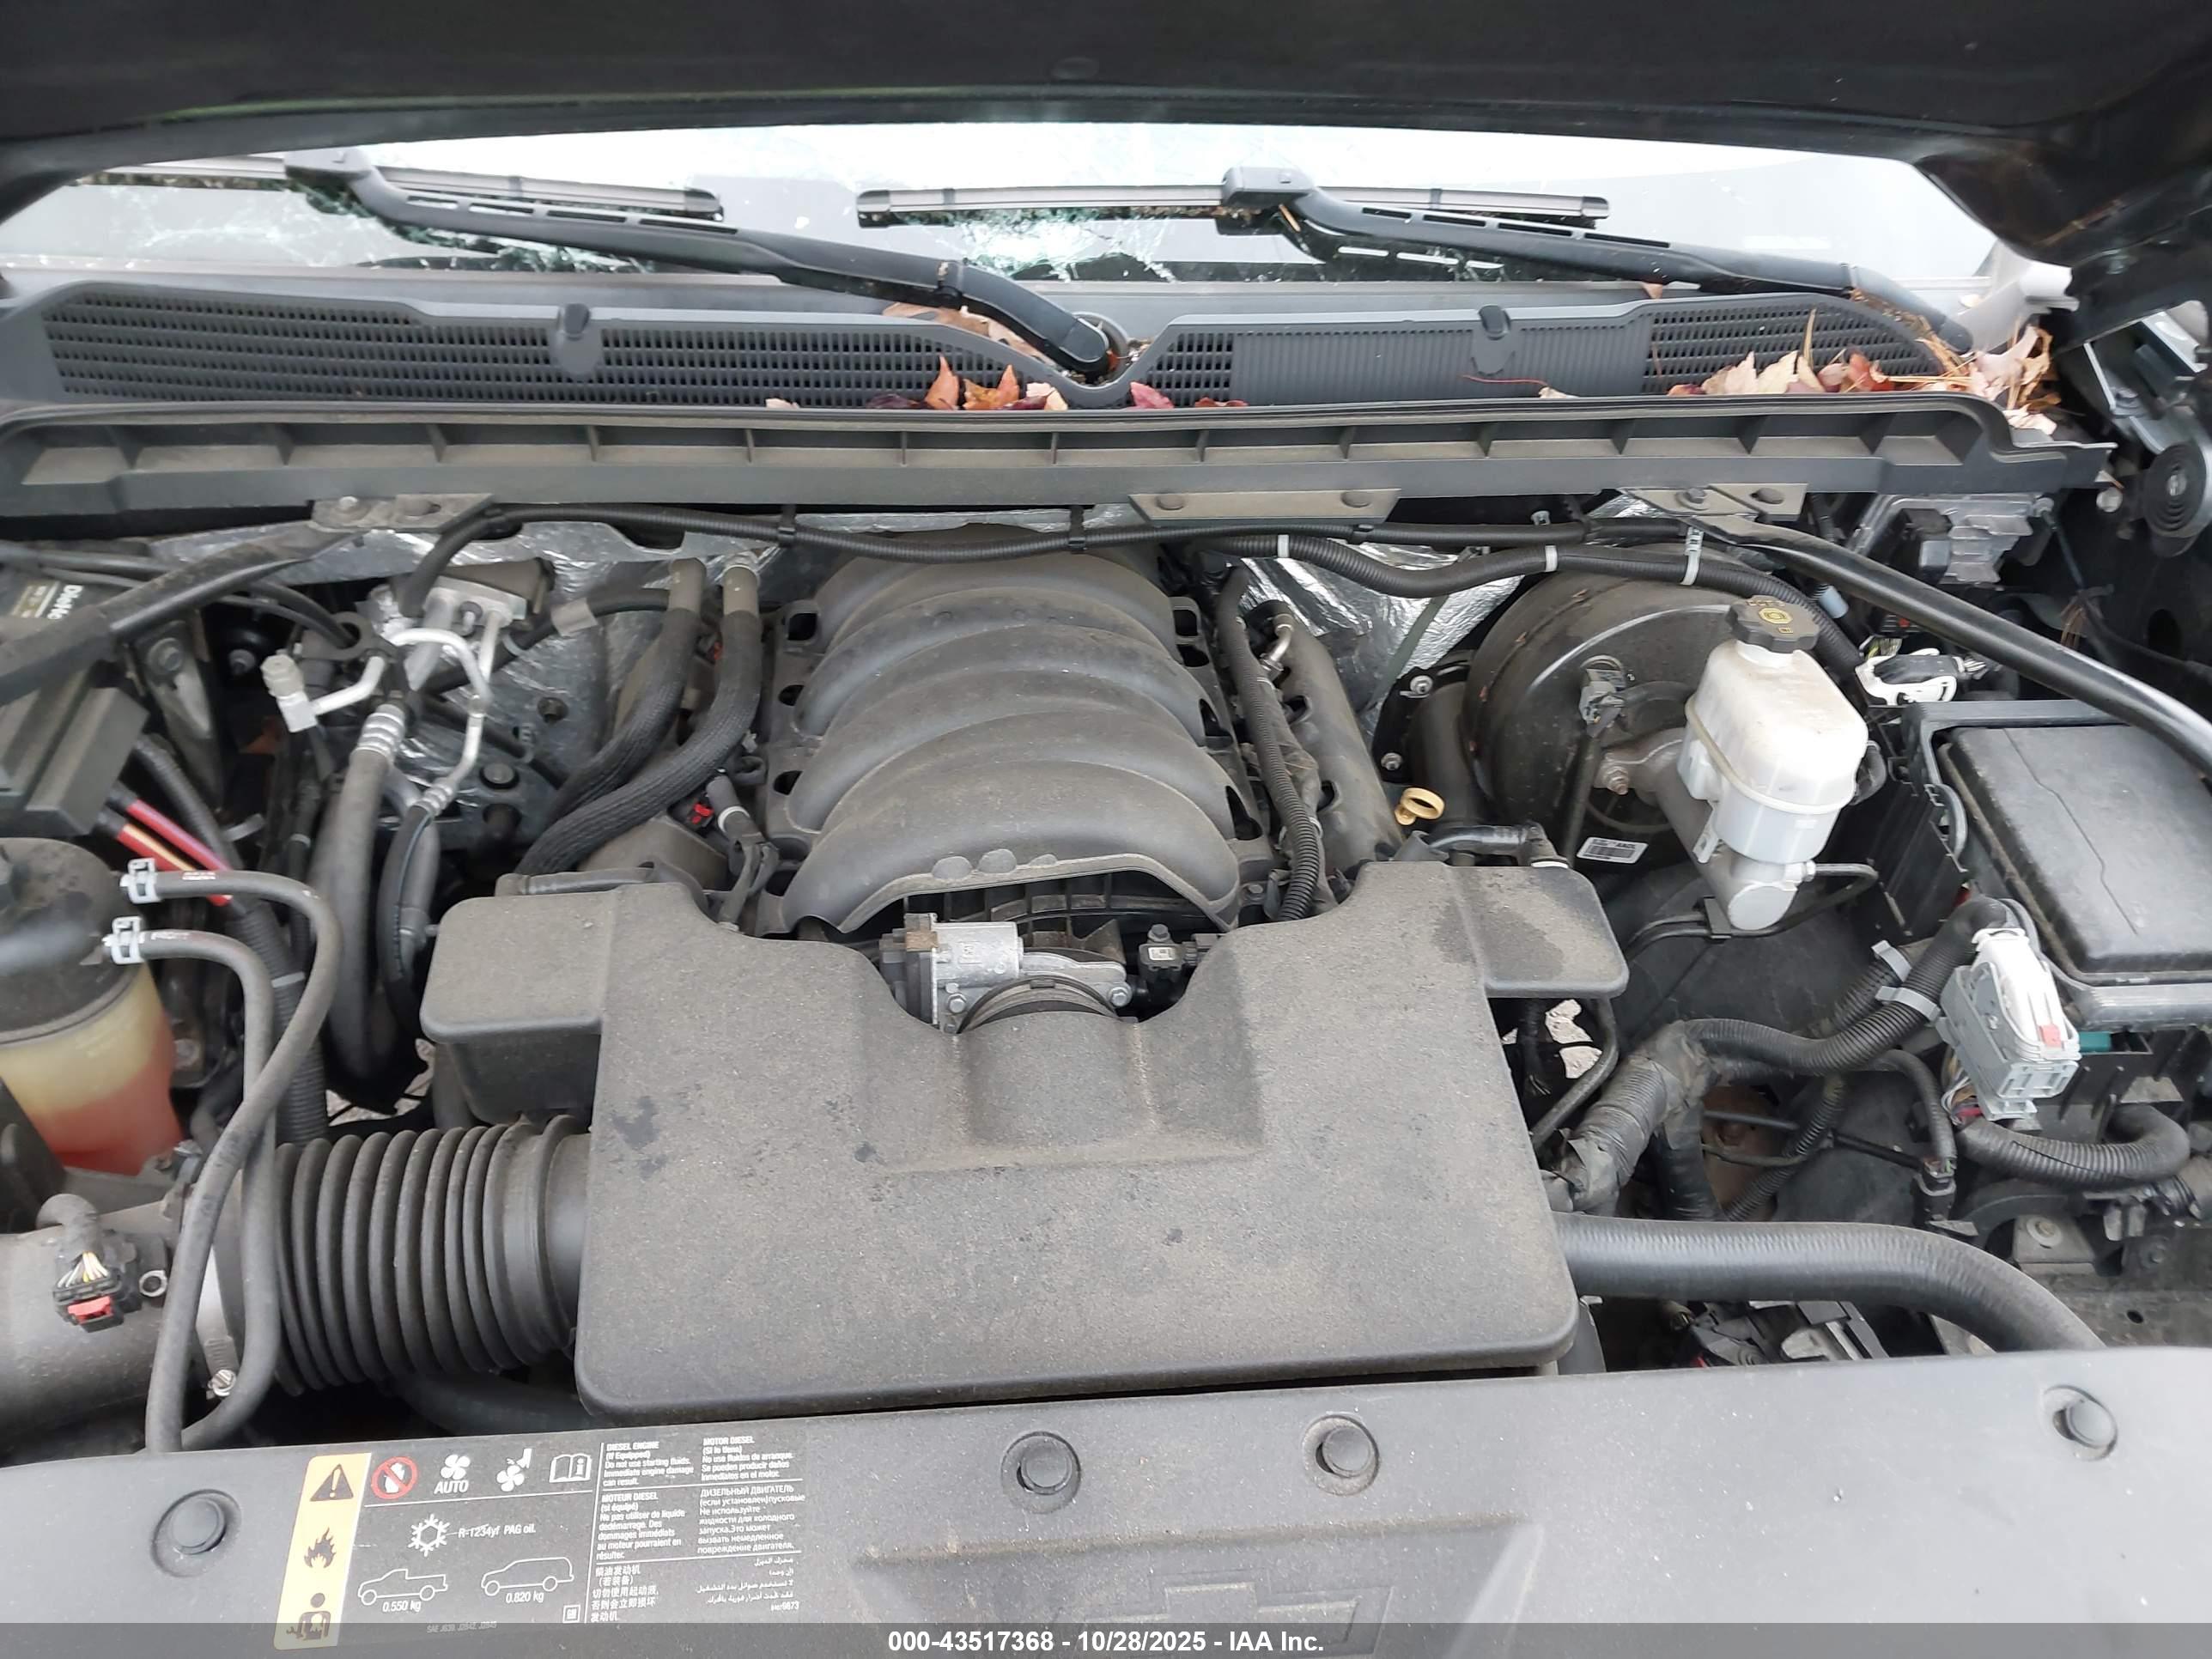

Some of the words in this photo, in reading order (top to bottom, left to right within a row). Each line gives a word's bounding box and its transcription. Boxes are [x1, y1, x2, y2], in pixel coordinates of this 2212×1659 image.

[606, 1443, 631, 1451] DIESEL
[632, 1441, 659, 1449] ENGINE
[703, 1437, 729, 1446] MOTOR
[730, 1436, 755, 1444] DIESEL
[641, 1459, 669, 1468] starting
[712, 1463, 738, 1473] pueden
[738, 1462, 768, 1471] producir
[768, 1461, 790, 1469] daños
[604, 1468, 641, 1477] Immediate
[641, 1468, 665, 1476] engine
[666, 1466, 694, 1474] damage
[434, 1480, 469, 1494] AUTO
[700, 1486, 750, 1498] ДИЗЕЛЬНЫЙ
[750, 1485, 794, 1495] ДВИГАТЕЛЬ
[602, 1493, 632, 1503] MOTEUR
[633, 1492, 659, 1501] DIESEL
[625, 1511, 650, 1520] utiliser
[661, 1509, 686, 1518] liquide
[711, 1504, 762, 1515] используйте
[698, 1516, 738, 1525] жидкости
[738, 1515, 753, 1523] для
[753, 1513, 795, 1522] холодного
[458, 1523, 501, 1539] R-1234yf
[503, 1524, 522, 1535] PAG
[598, 1531, 637, 1540] dommages
[638, 1528, 676, 1538] immédiats
[607, 1540, 634, 1549] moteur
[634, 1538, 672, 1549] pourraient
[697, 1535, 730, 1544] вызвать
[731, 1533, 784, 1542] немедленное
[505, 1590, 531, 1603] 0.820
[532, 1590, 544, 1602] kg
[382, 1601, 409, 1613] 0.550
[409, 1600, 422, 1612] kg
